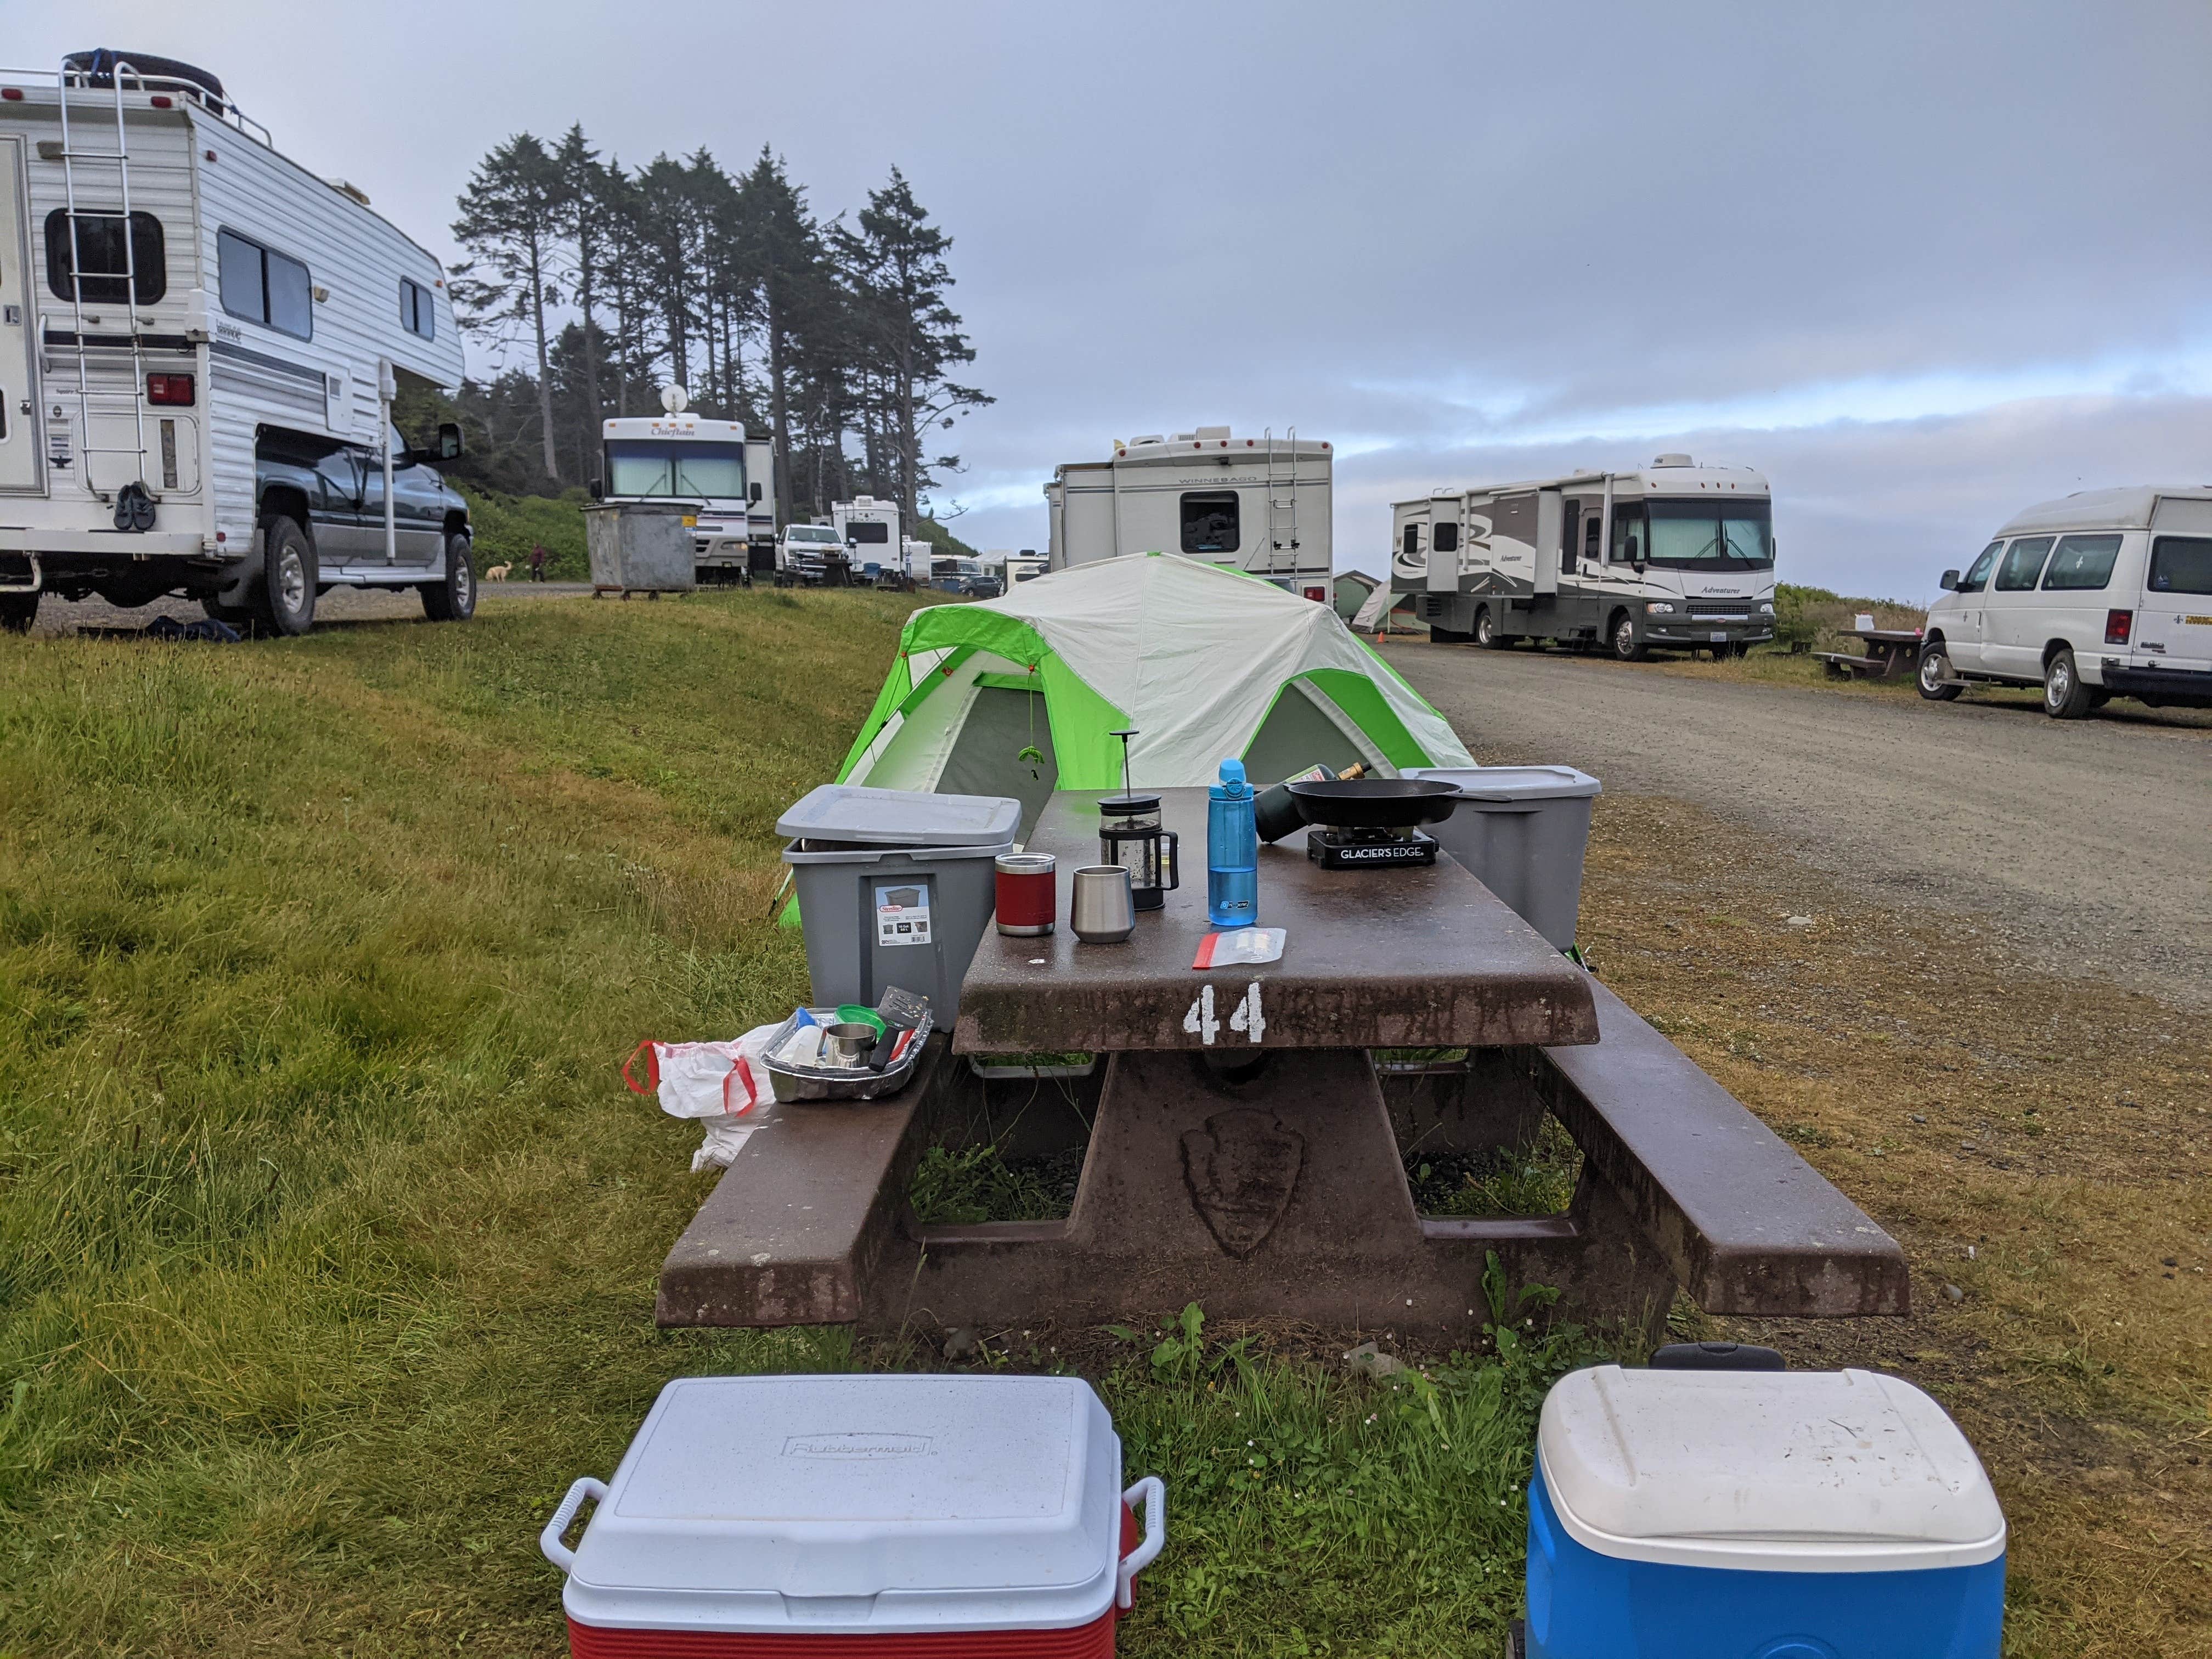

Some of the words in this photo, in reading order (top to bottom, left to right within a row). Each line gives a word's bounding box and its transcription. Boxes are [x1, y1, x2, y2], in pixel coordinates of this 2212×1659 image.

[651, 427, 695, 437] Chieftain
[1340, 848, 1392, 859] GLACIER'S
[1183, 981, 1266, 1046] 44
[790, 1442, 927, 1454] Rubbermaid
